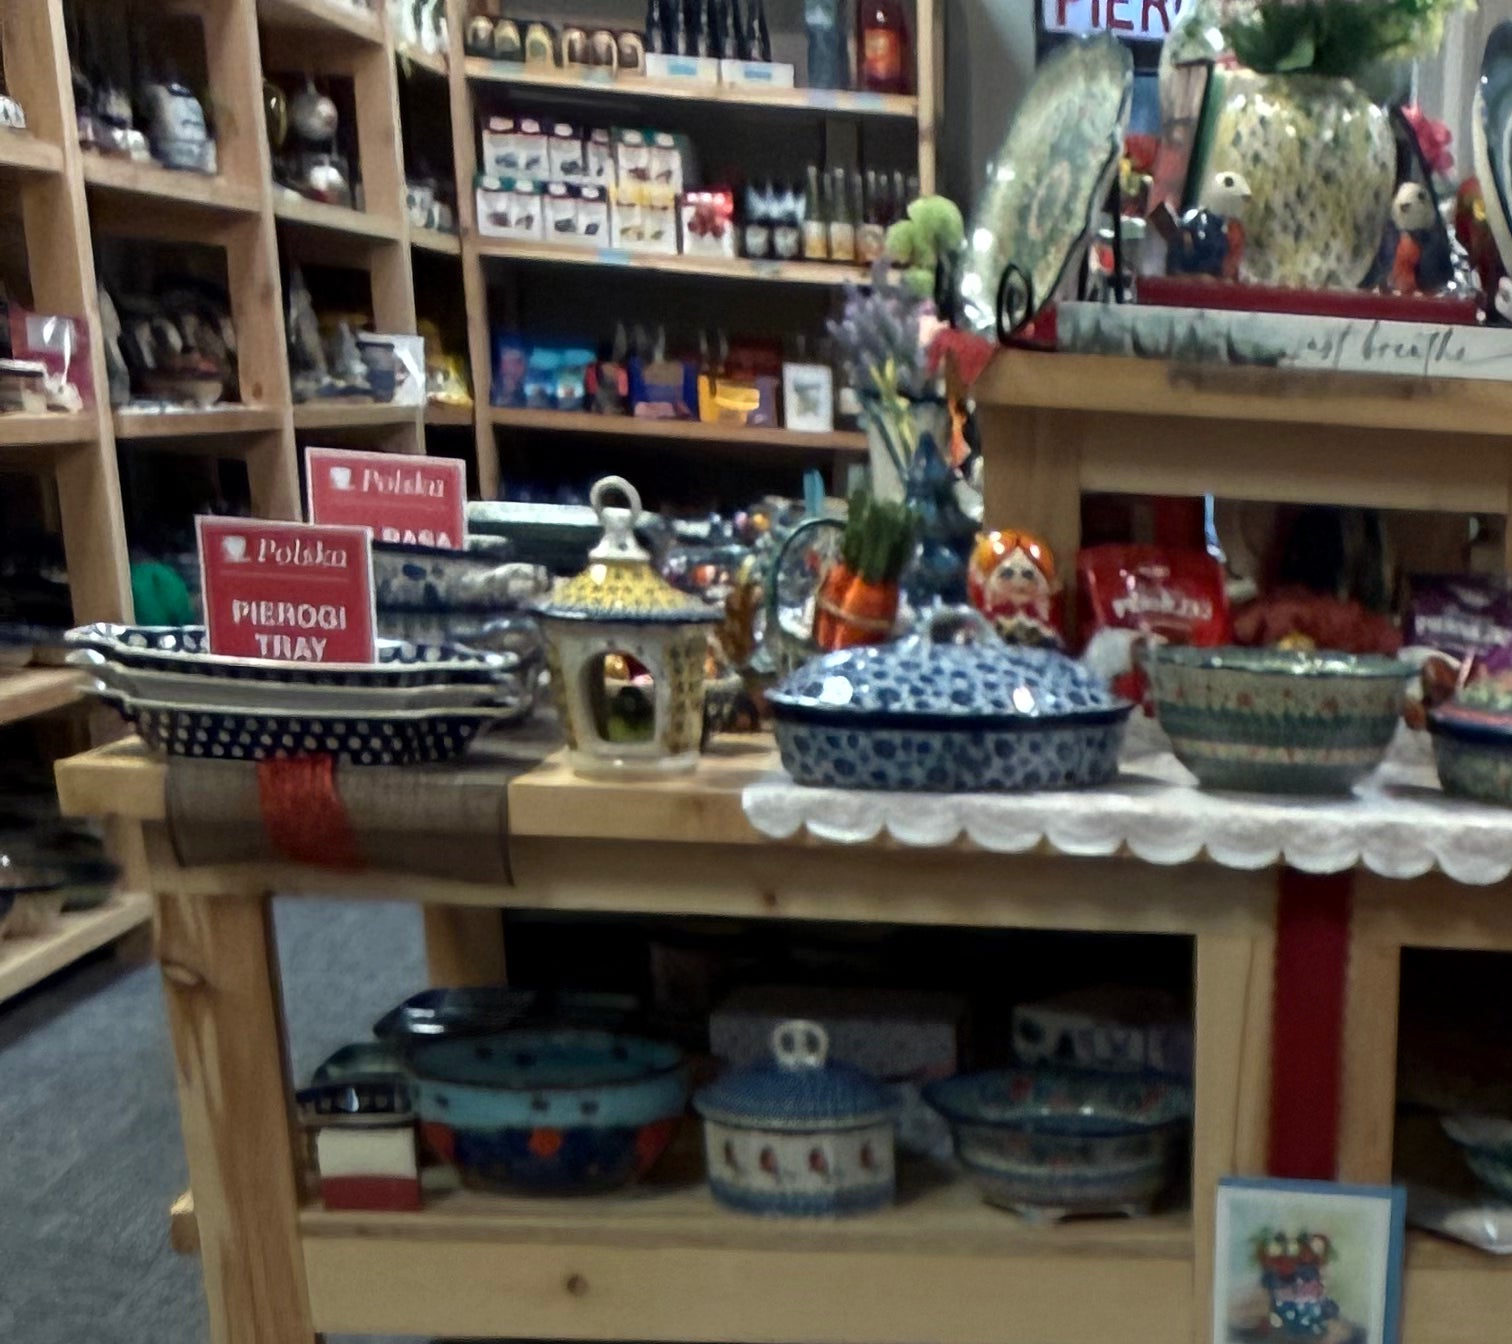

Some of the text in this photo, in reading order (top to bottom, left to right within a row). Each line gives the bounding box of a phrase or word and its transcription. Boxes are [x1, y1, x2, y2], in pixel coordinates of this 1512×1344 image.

[362, 468, 445, 498] Polska
[257, 538, 347, 568] Polska
[232, 599, 347, 630] PIEROGI
[255, 633, 327, 662] TRAY
